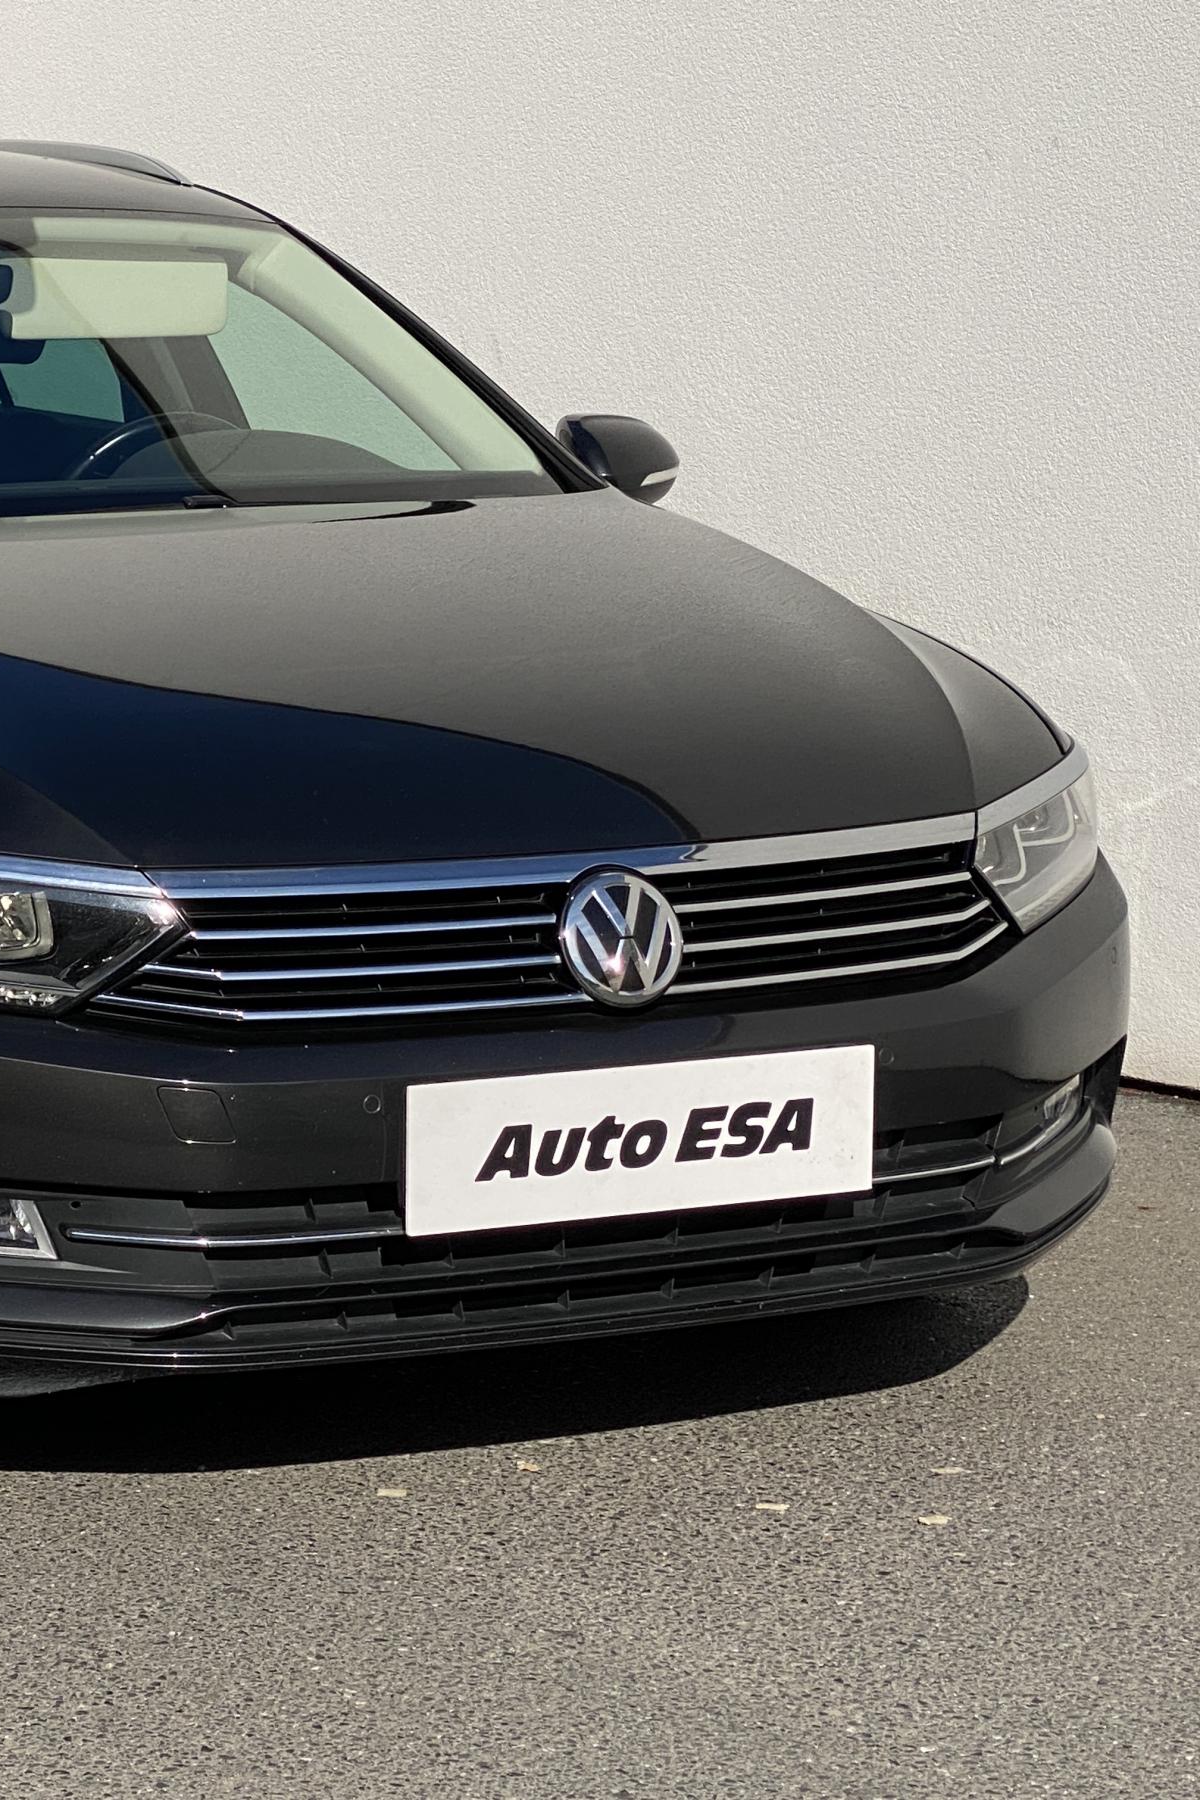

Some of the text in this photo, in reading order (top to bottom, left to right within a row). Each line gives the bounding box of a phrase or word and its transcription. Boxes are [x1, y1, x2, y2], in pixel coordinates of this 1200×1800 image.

[567, 876, 678, 1004] VW
[475, 1097, 814, 1182] Auto ESA
